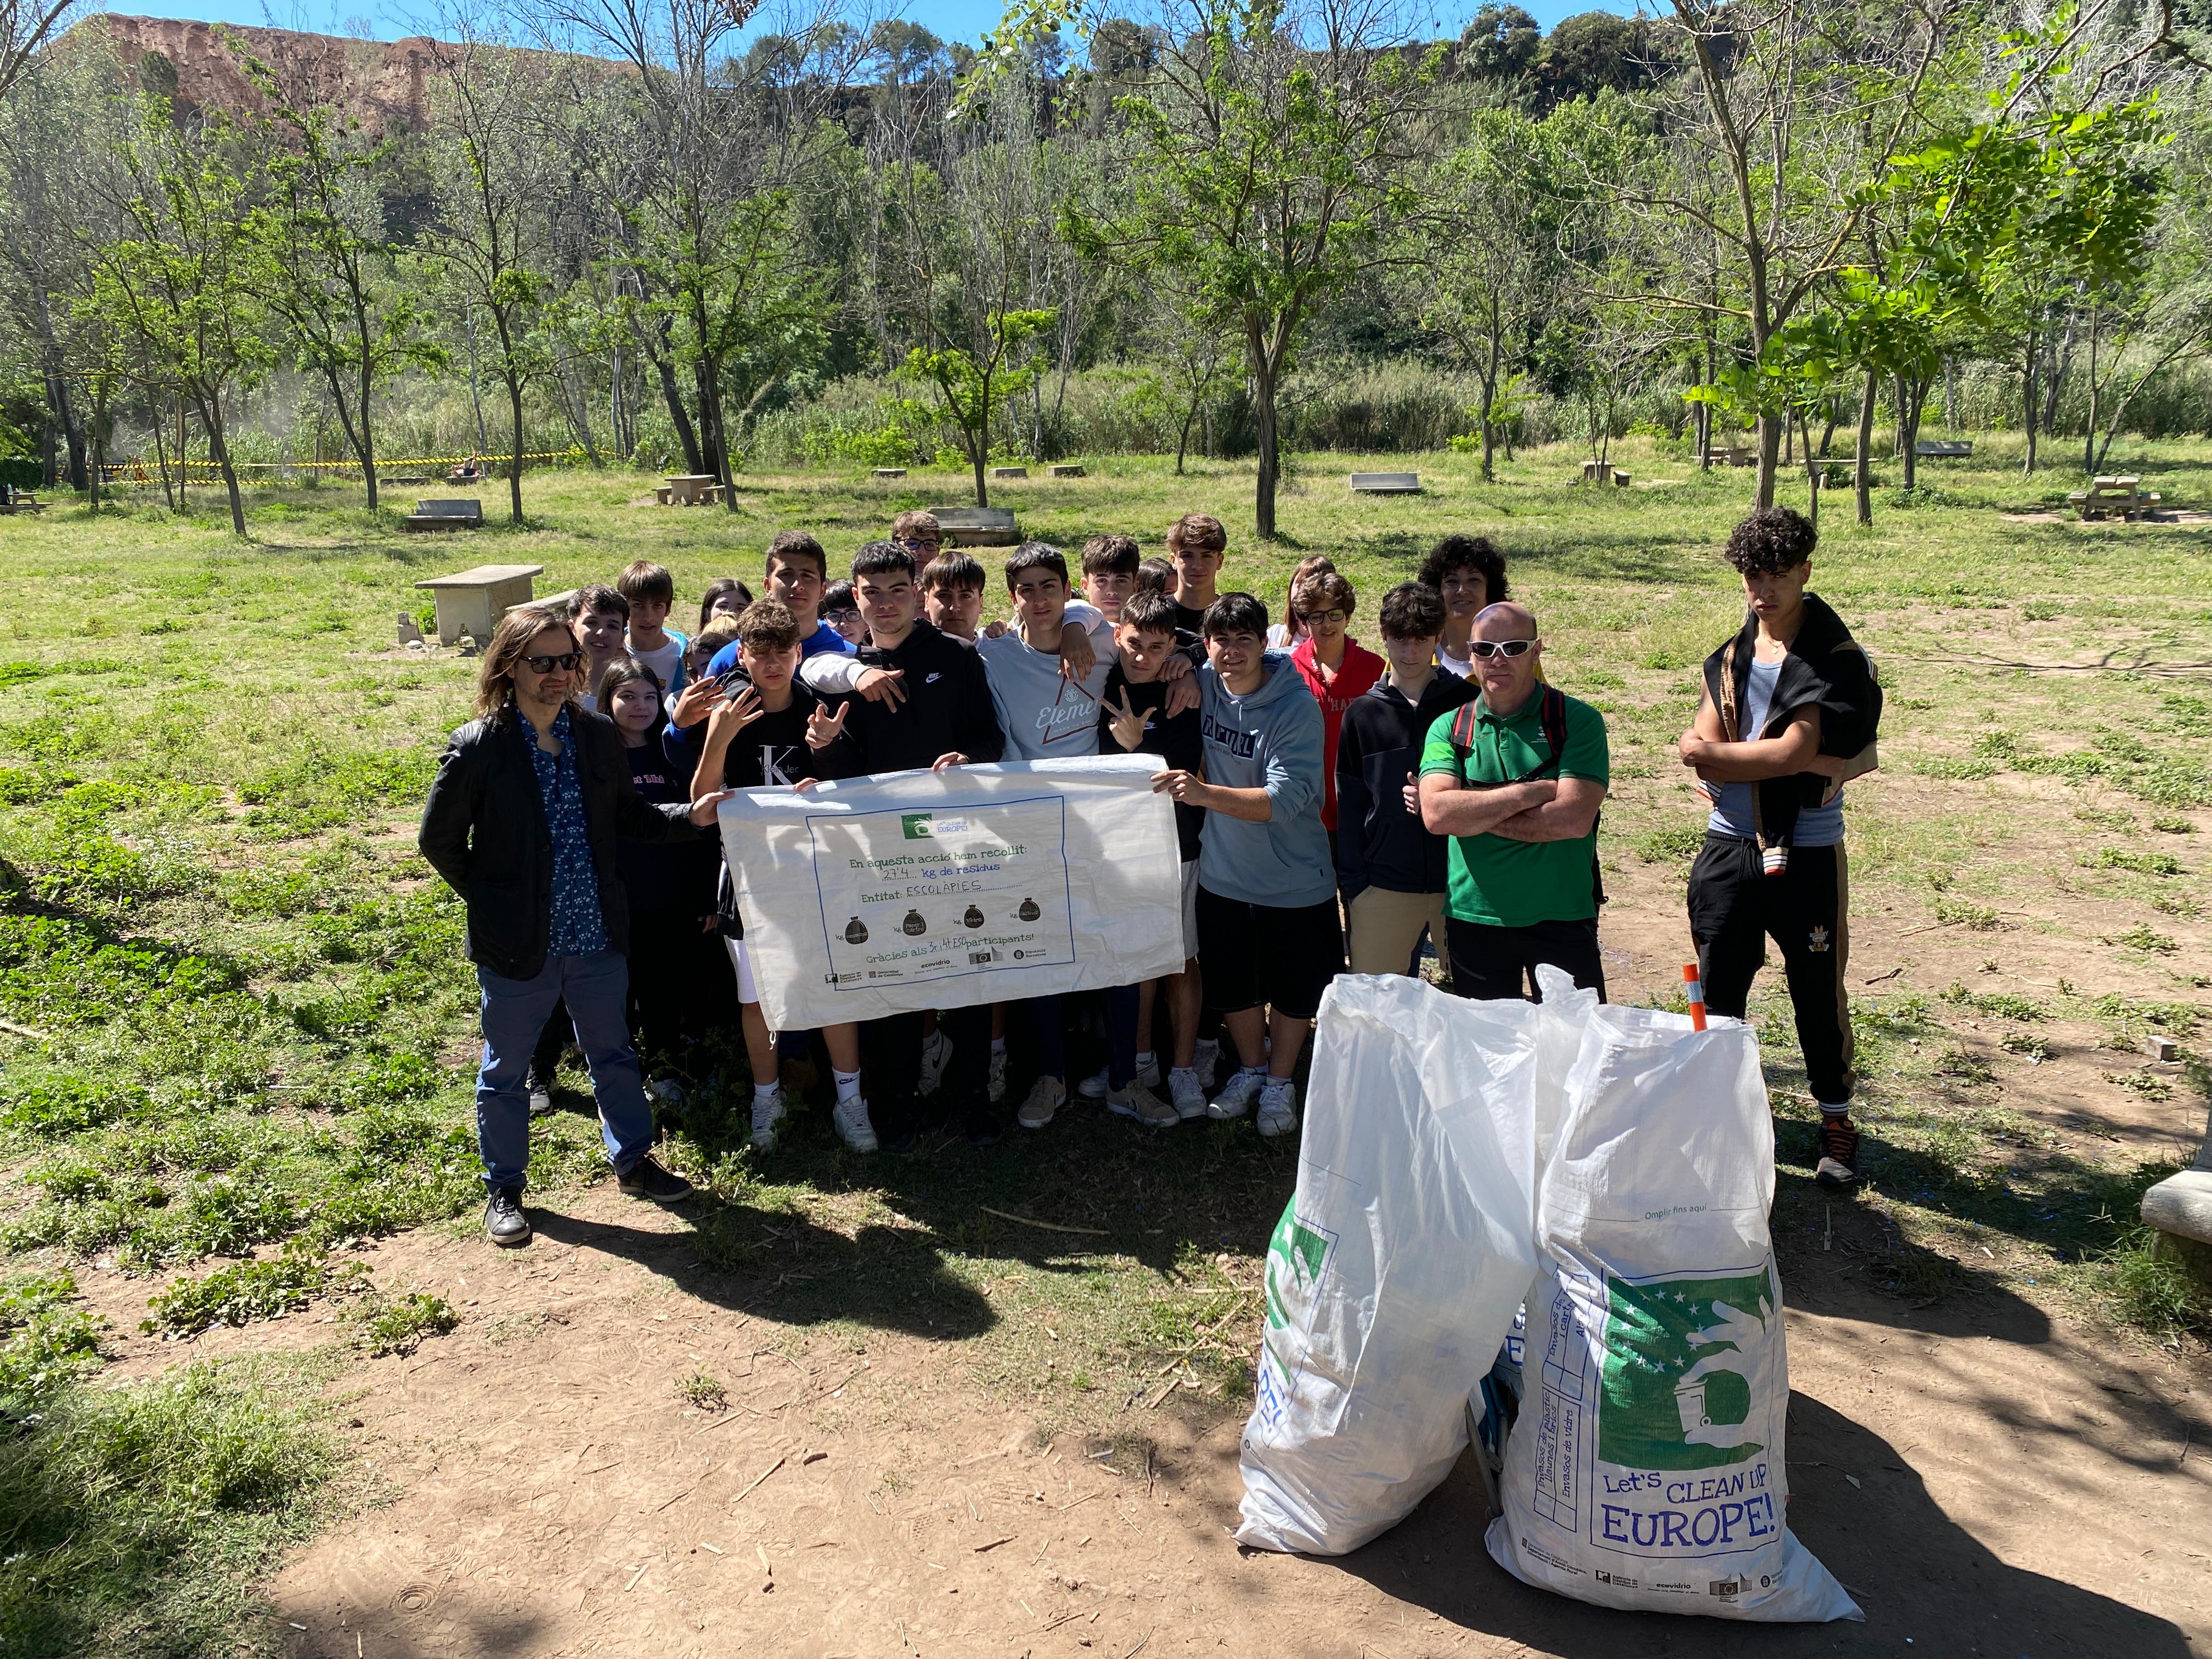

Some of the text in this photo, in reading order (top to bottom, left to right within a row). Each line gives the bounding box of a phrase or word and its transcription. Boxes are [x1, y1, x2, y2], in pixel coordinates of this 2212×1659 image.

[759, 745, 798, 786] K
[849, 844, 1027, 870] En aquesta acció hem recollit:
[921, 864, 1000, 879] kg de residus
[861, 890, 902, 902] Entitat:
[966, 933, 1034, 950] participants!
[866, 947, 927, 963] Gràcies als
[921, 959, 950, 968] ecovidrio
[1645, 1209, 1671, 1219] Omplir
[1561, 1302, 1575, 1331] cartr
[1549, 1299, 1565, 1357] Envasos de
[1540, 1432, 1547, 1444] de
[1564, 1441, 1572, 1452] de
[1545, 1442, 1554, 1483] llaunes
[1562, 1455, 1571, 1498] Envasos
[1603, 1463, 1767, 1504] Let's CLEAN UP
[1601, 1493, 1775, 1547] EUROPE!
